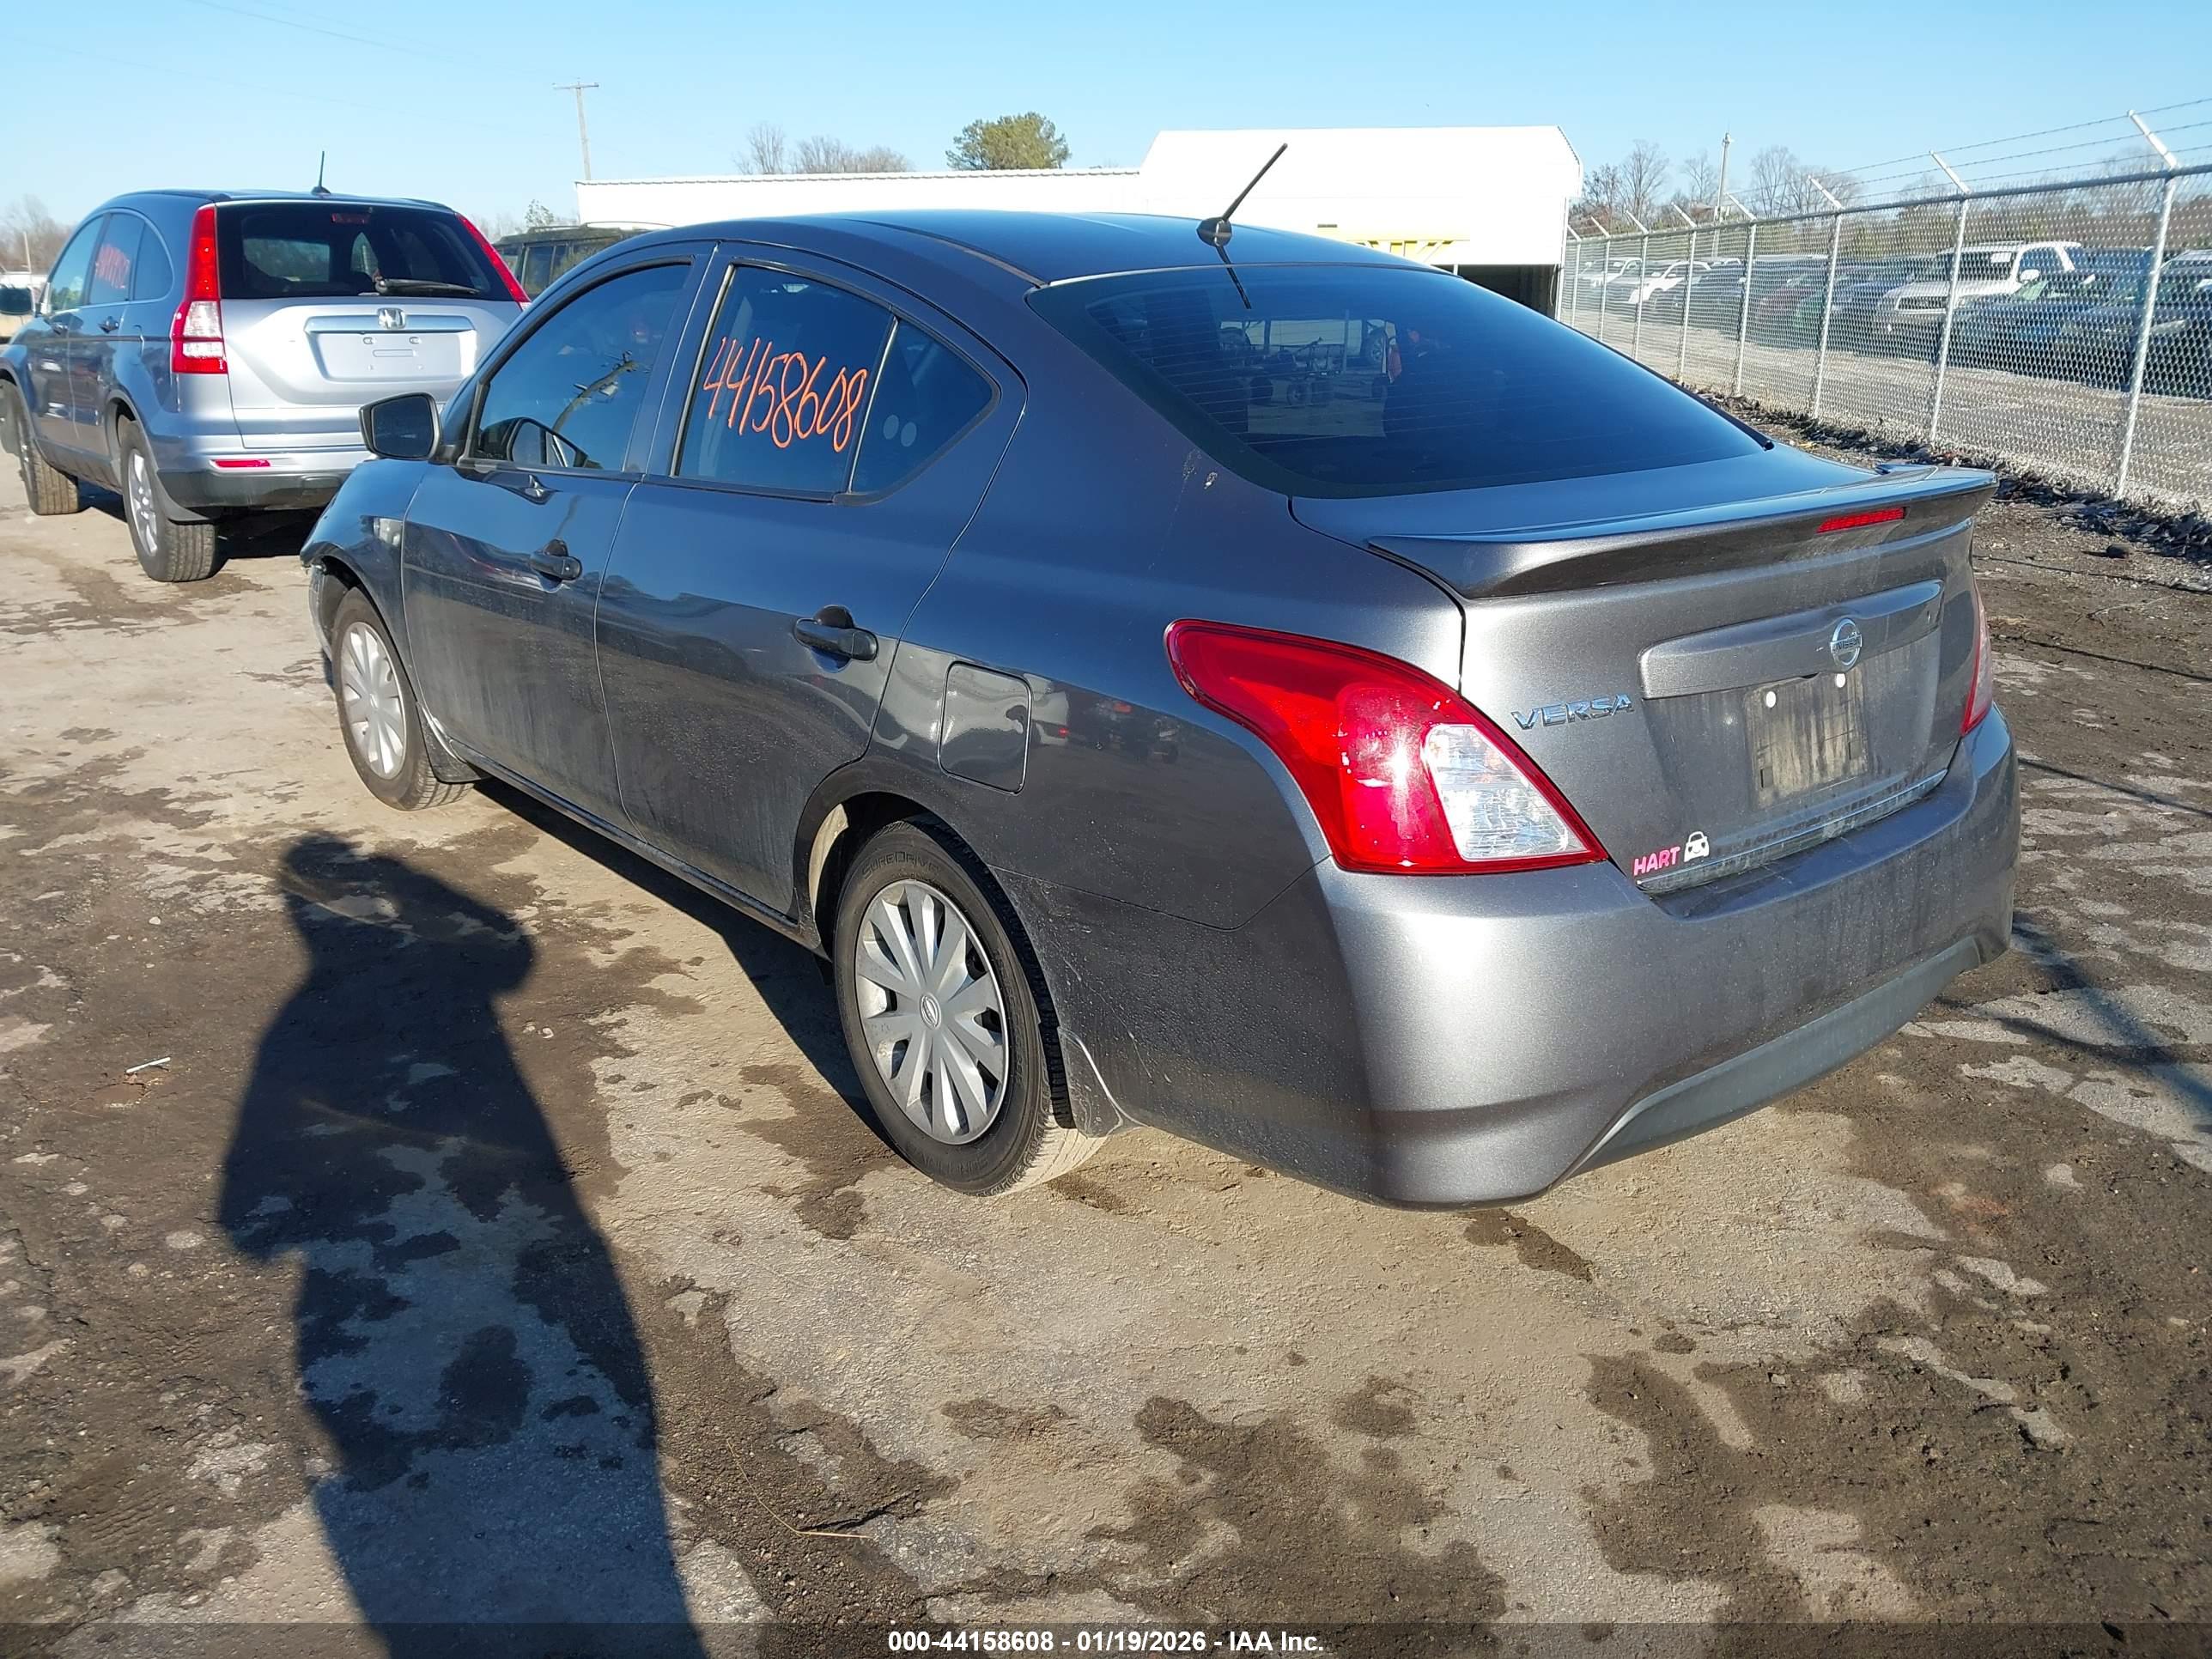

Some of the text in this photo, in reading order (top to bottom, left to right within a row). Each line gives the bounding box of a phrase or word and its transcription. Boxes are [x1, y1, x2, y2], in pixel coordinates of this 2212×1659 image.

[703, 337, 867, 453] 44158608
[1510, 694, 1634, 730] VERSA
[1633, 847, 1680, 876] HART
